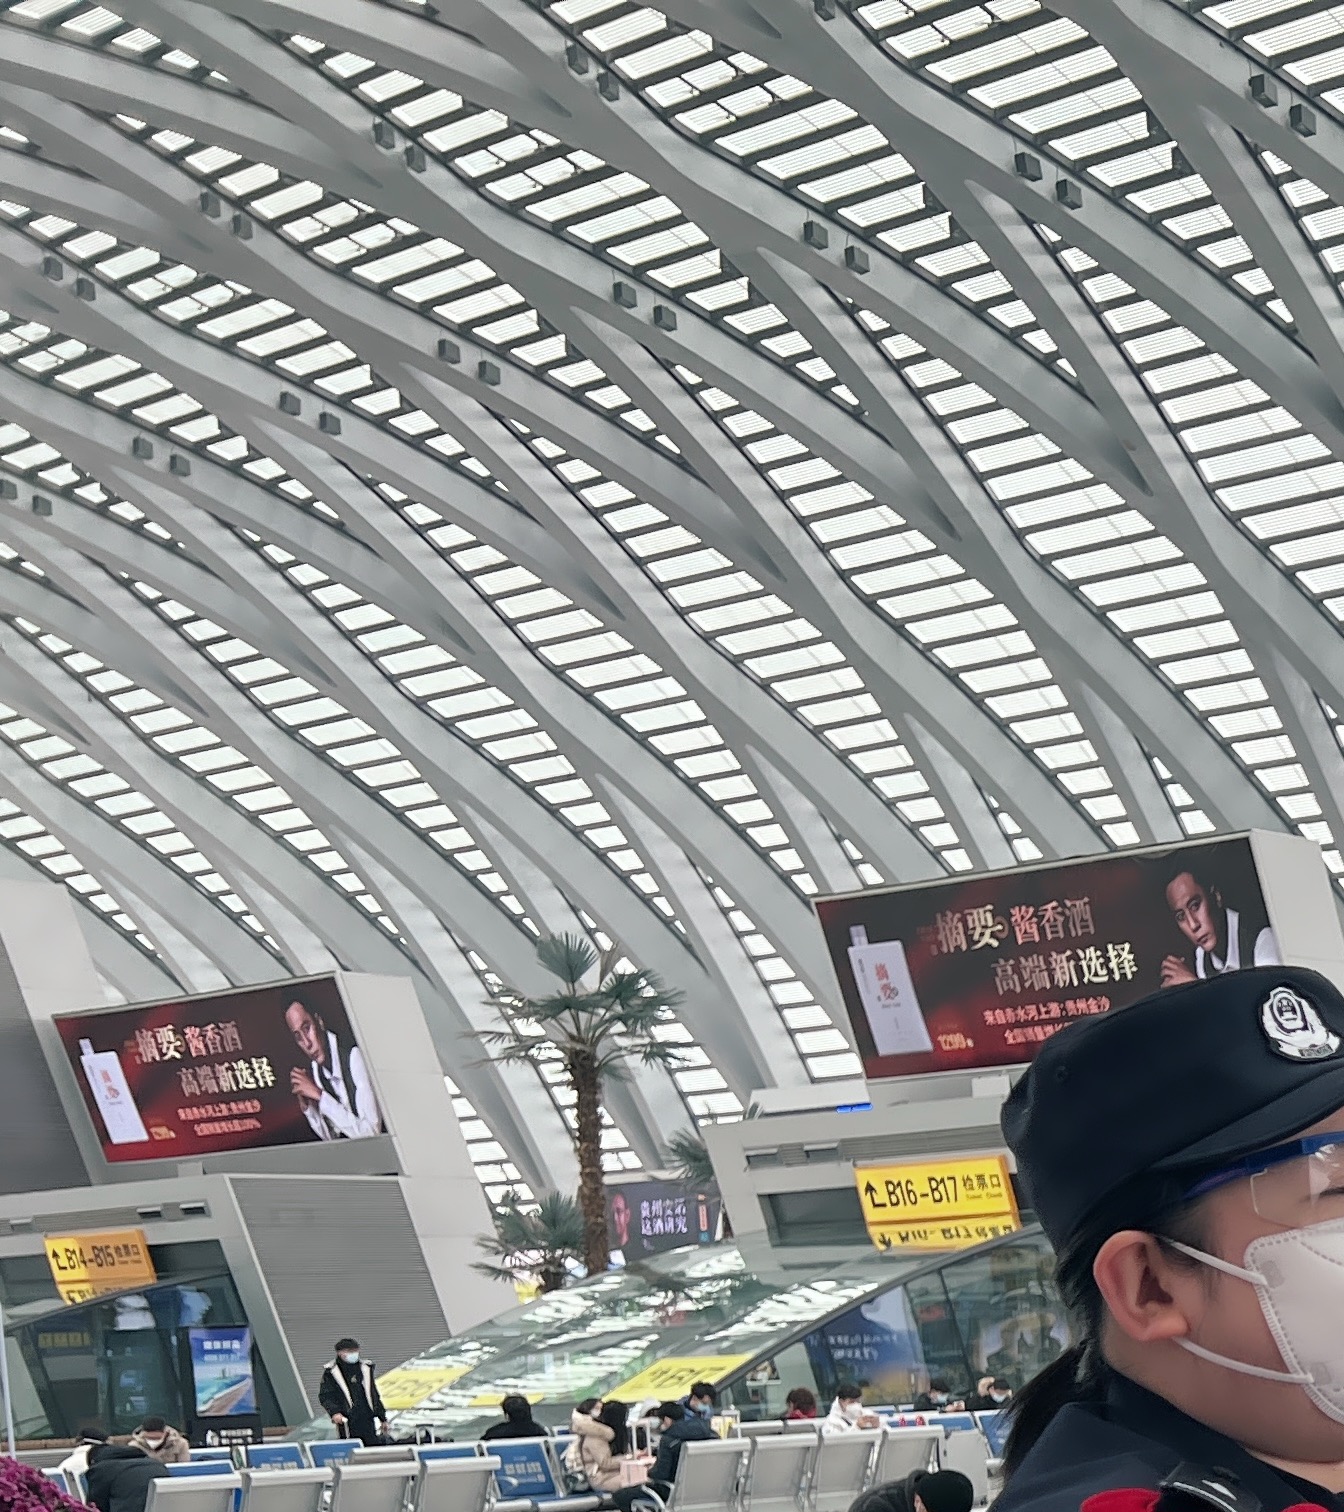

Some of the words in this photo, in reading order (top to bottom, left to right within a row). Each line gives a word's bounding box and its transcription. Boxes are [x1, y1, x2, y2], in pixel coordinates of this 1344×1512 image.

[1009, 896, 1096, 946] 酱香酒
[991, 942, 1139, 996] 高端新选择
[176, 1056, 277, 1098] 高端新选择
[884, 1175, 958, 1208] B16-B17
[961, 1173, 1002, 1192] 检票口
